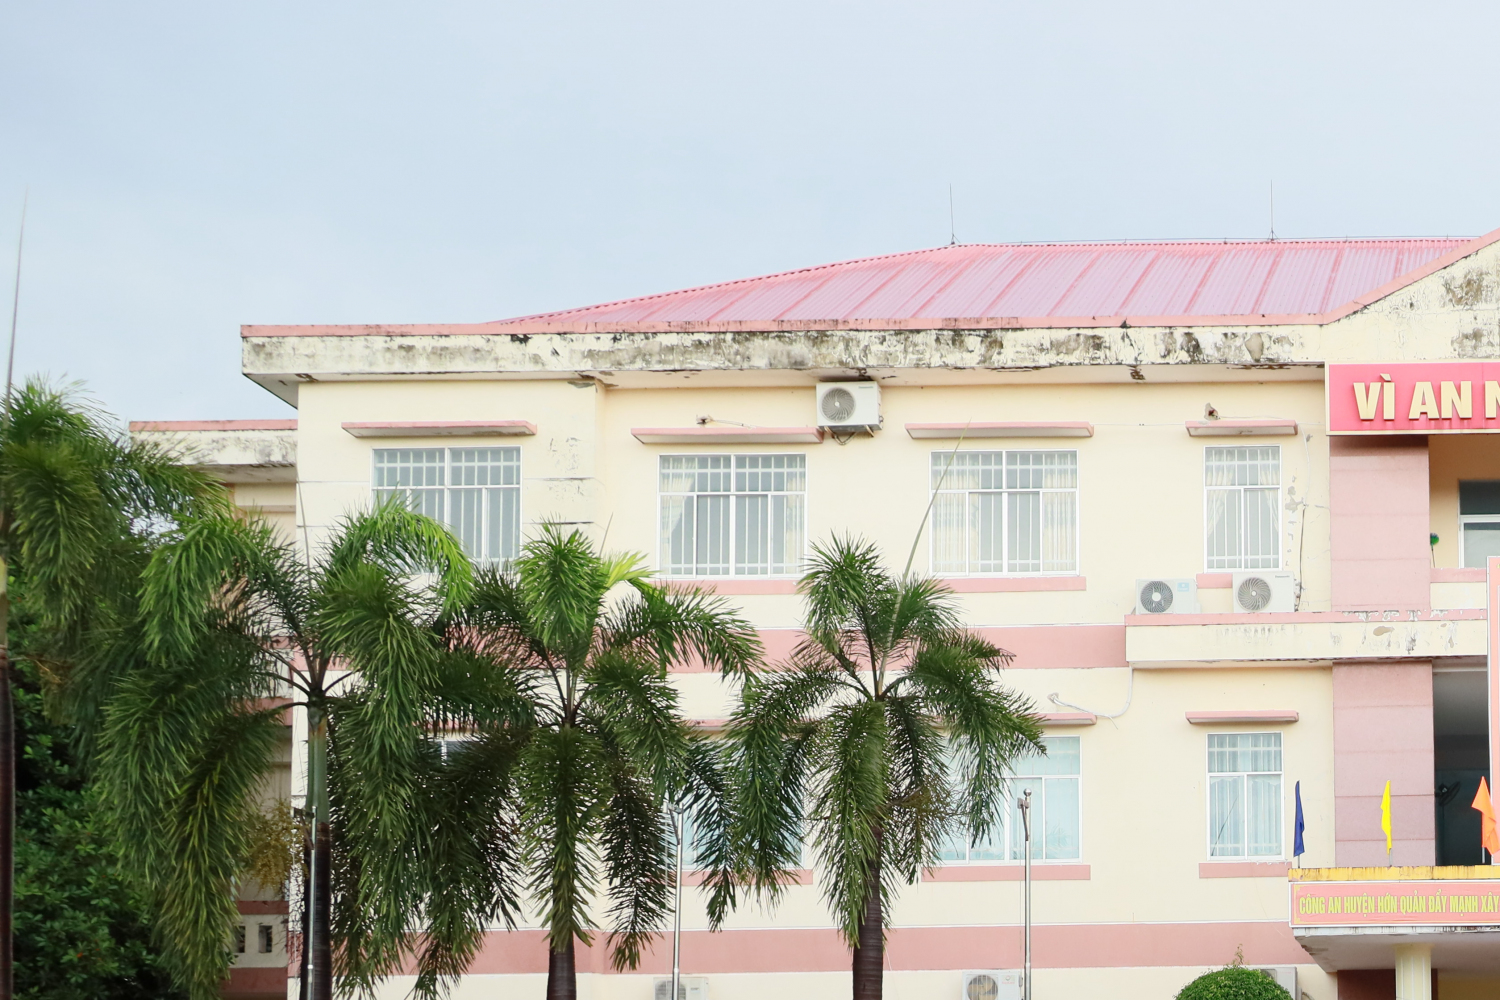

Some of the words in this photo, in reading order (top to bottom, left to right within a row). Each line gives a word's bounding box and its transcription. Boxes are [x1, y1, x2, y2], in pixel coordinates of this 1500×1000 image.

[1353, 373, 1395, 421] VÌ
[1408, 380, 1473, 420] AN
[1299, 894, 1326, 914] CÔNG
[1328, 897, 1342, 914] AN
[1344, 893, 1375, 917] HUYỆN
[1377, 892, 1398, 914] HỚN
[1400, 890, 1426, 915] QUẢN
[1428, 888, 1448, 914] ĐẨY
[1449, 895, 1479, 917] MẠNH
[1480, 891, 1500, 913] XÂY
